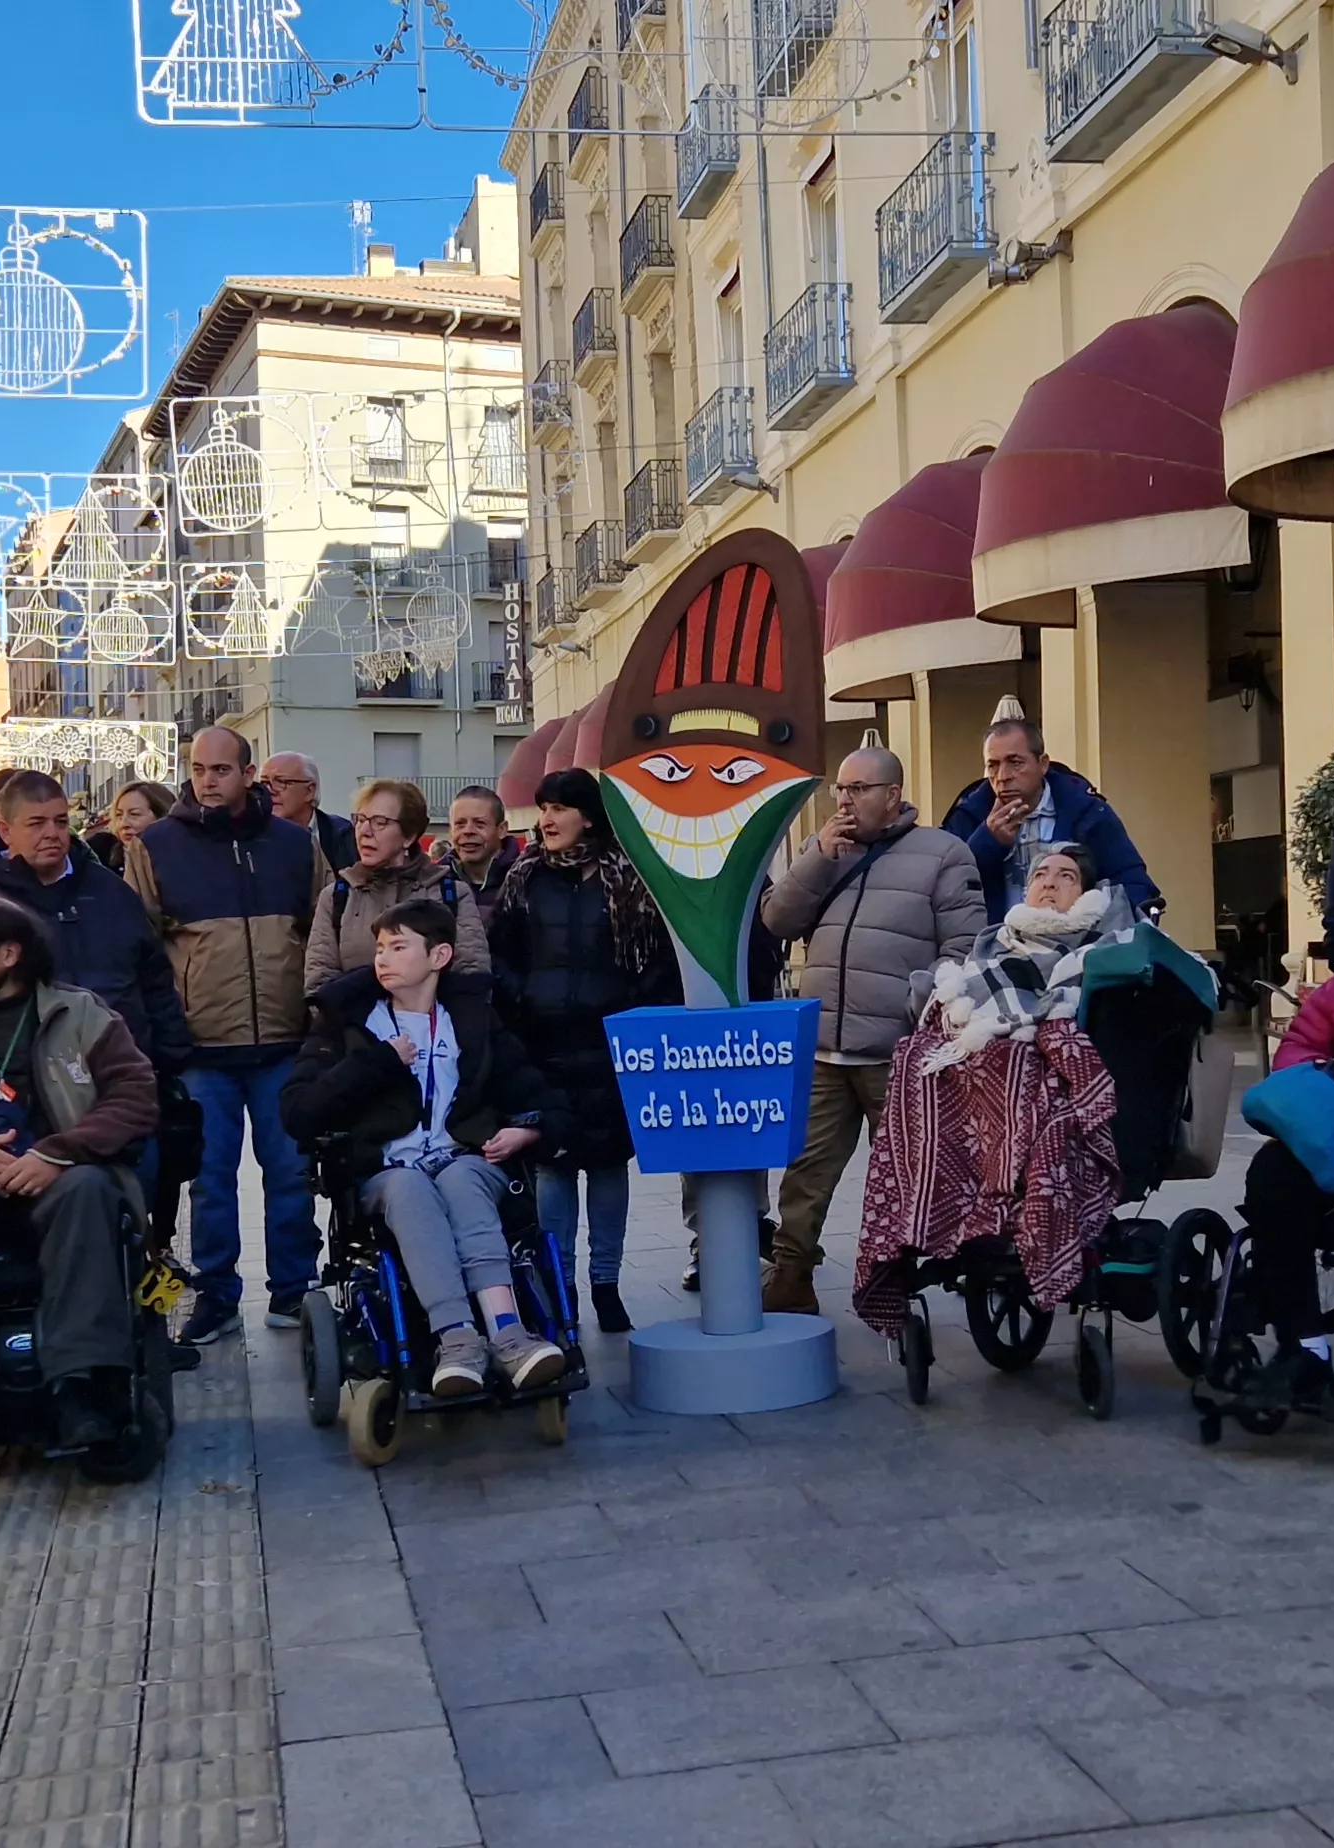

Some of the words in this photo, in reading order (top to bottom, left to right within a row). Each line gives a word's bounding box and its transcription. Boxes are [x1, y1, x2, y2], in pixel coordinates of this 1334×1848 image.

[503, 582, 522, 700] HOSTAL
[612, 1036, 655, 1073] los
[661, 1029, 794, 1071] bandidos
[639, 1091, 673, 1128] de
[680, 1089, 708, 1127] la
[714, 1088, 785, 1133] hoya
